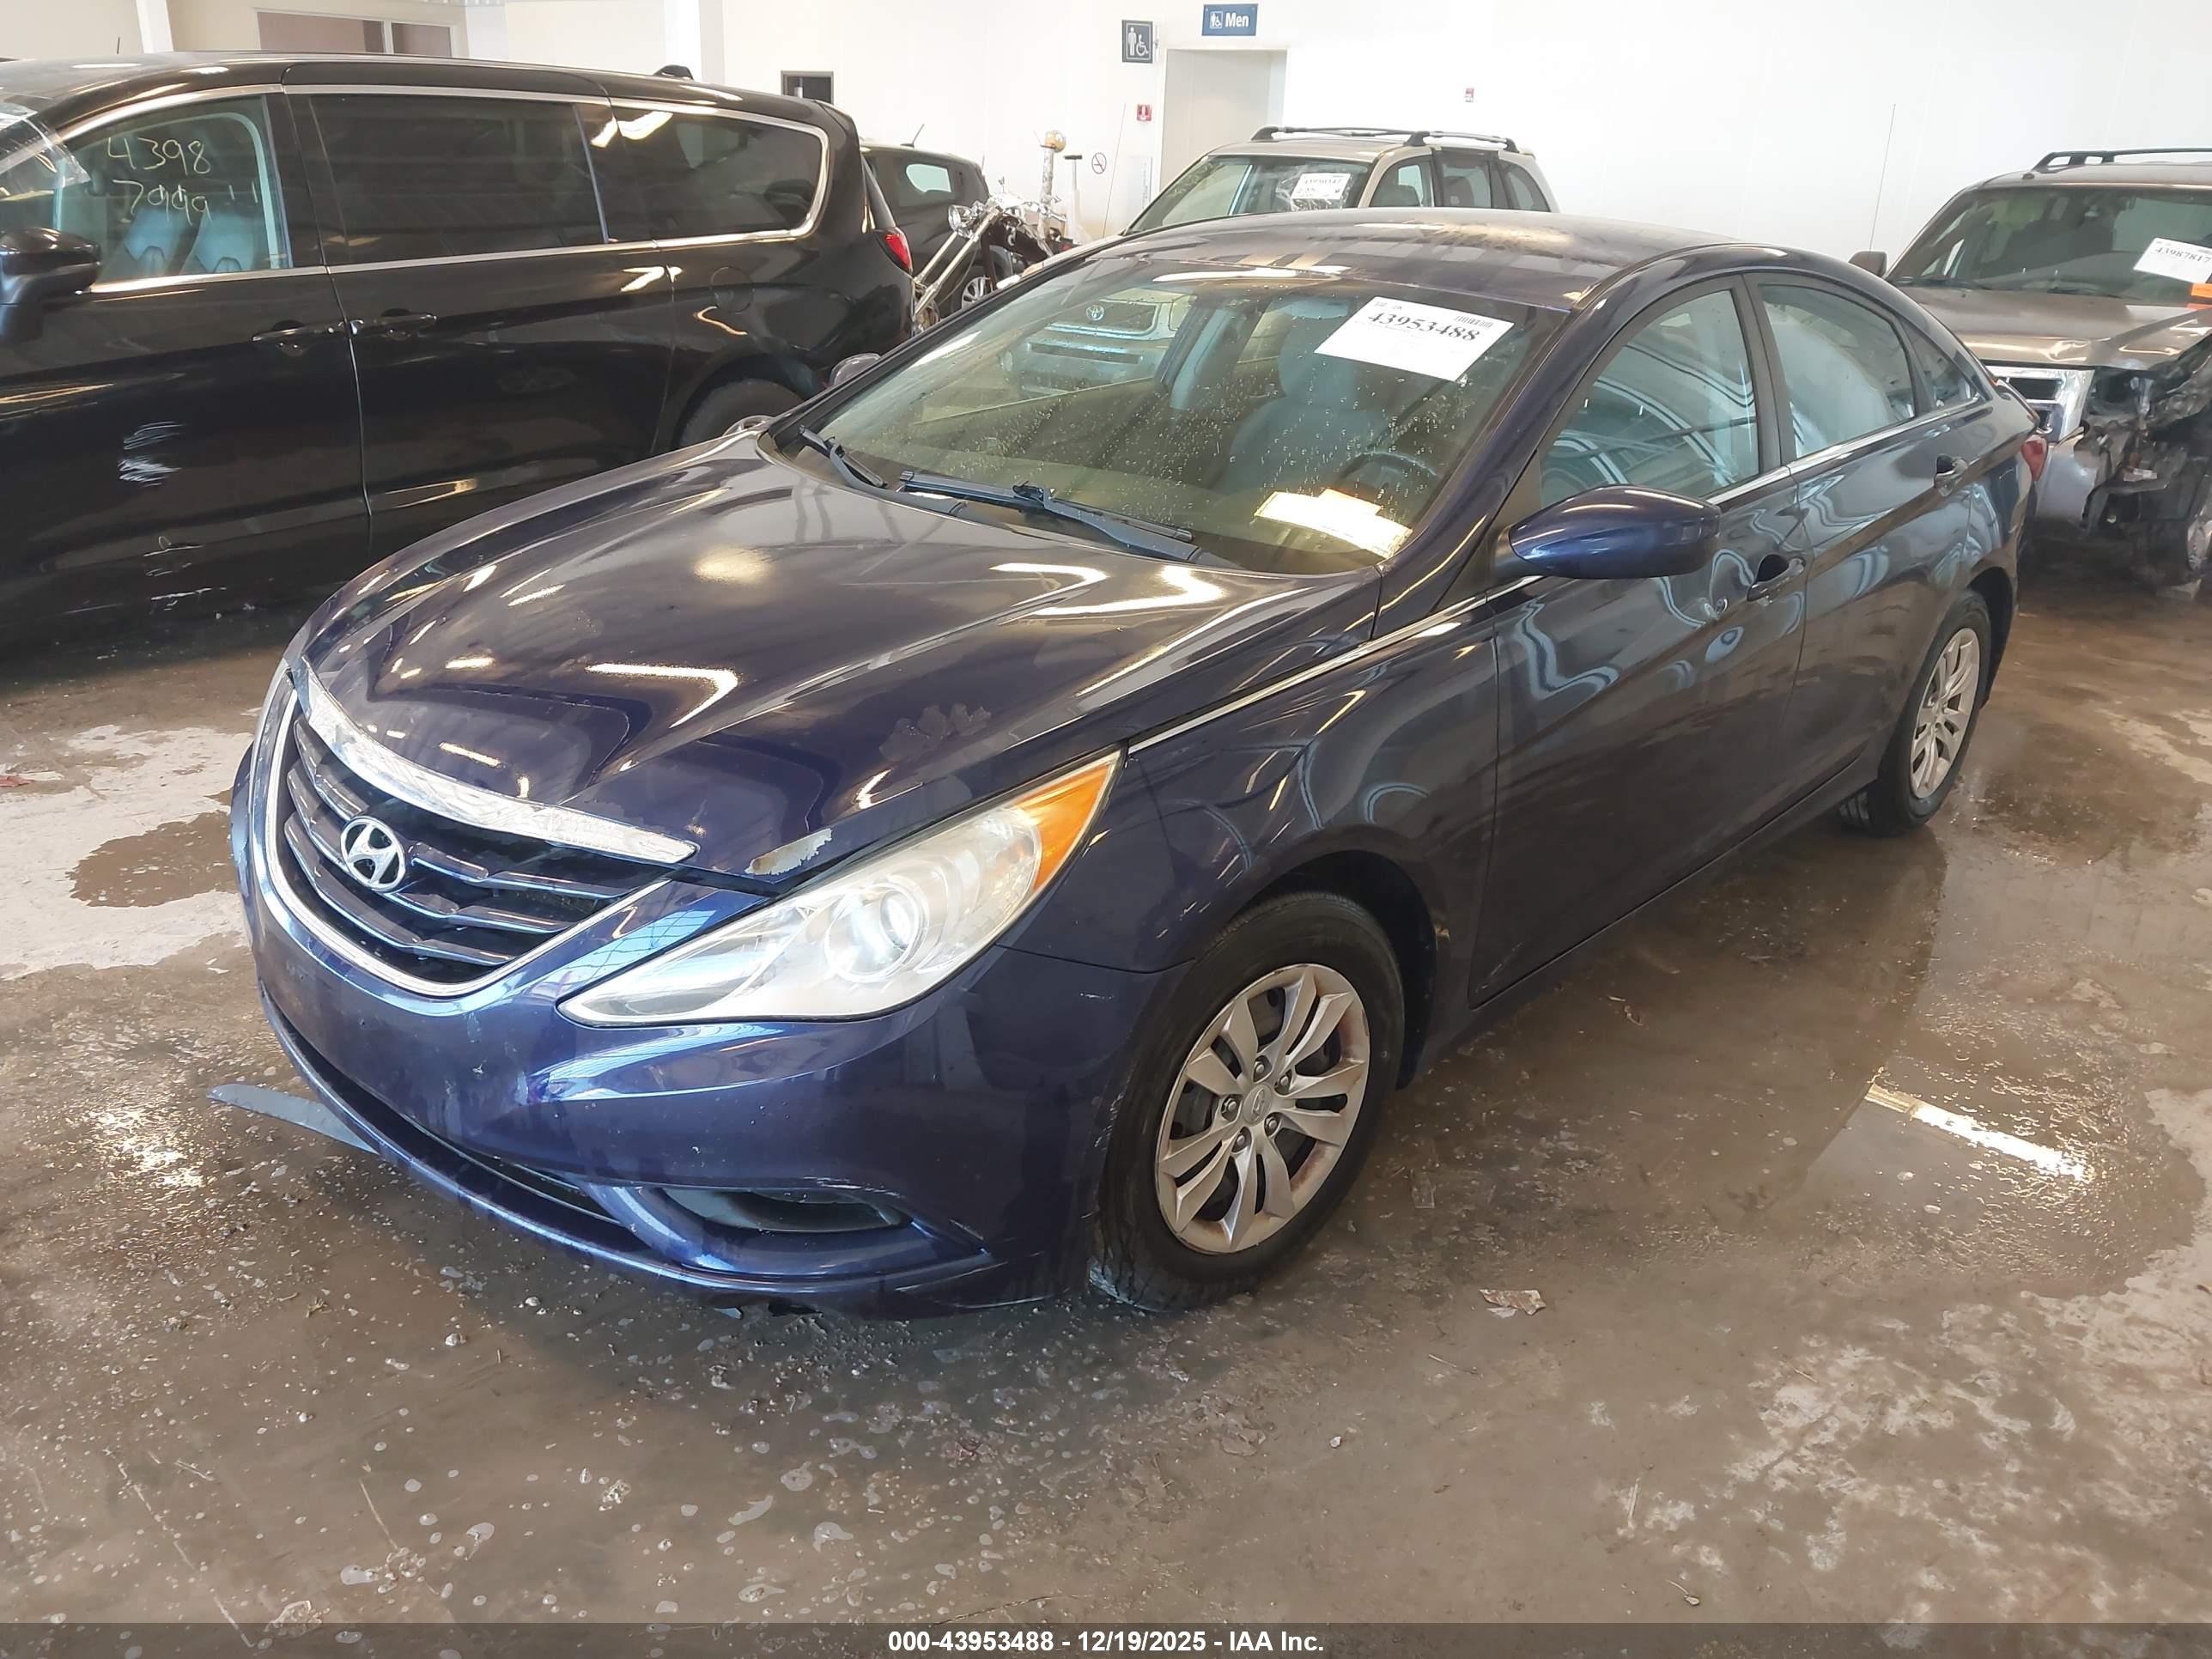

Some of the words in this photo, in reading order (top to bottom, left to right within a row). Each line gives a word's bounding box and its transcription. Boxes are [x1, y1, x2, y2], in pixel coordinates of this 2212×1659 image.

[1224, 12, 1249, 27] Men
[107, 137, 211, 176] 4398
[1368, 312, 1480, 341] 43953488
